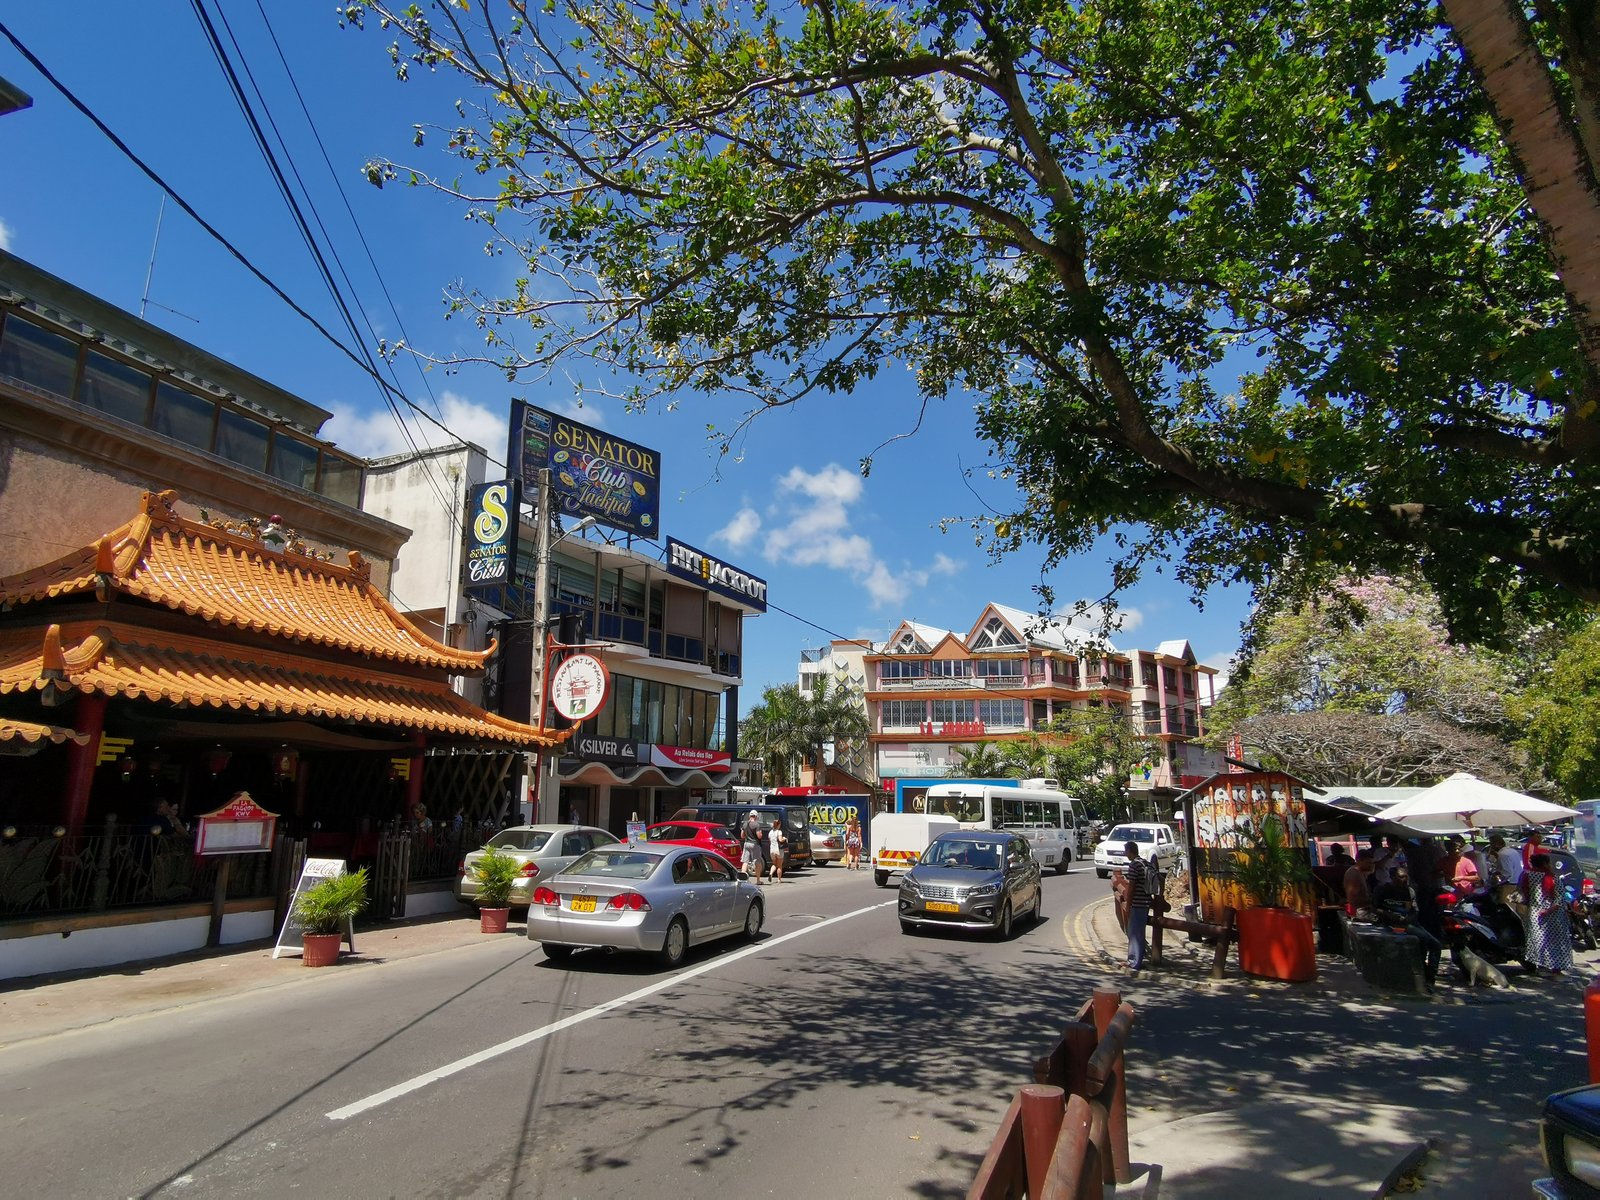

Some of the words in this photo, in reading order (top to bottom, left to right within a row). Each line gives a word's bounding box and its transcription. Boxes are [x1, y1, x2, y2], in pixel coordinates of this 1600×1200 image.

[553, 422, 655, 475] SENATOR
[582, 453, 626, 489] Club
[474, 485, 508, 543] S
[562, 481, 632, 517] Jackpot
[470, 545, 507, 558] SENATOR
[468, 559, 505, 581] Club
[671, 543, 702, 574] HIT
[708, 560, 766, 601] JACKPOT
[557, 659, 583, 698] RESTAURANT
[809, 805, 860, 824] ATOR
